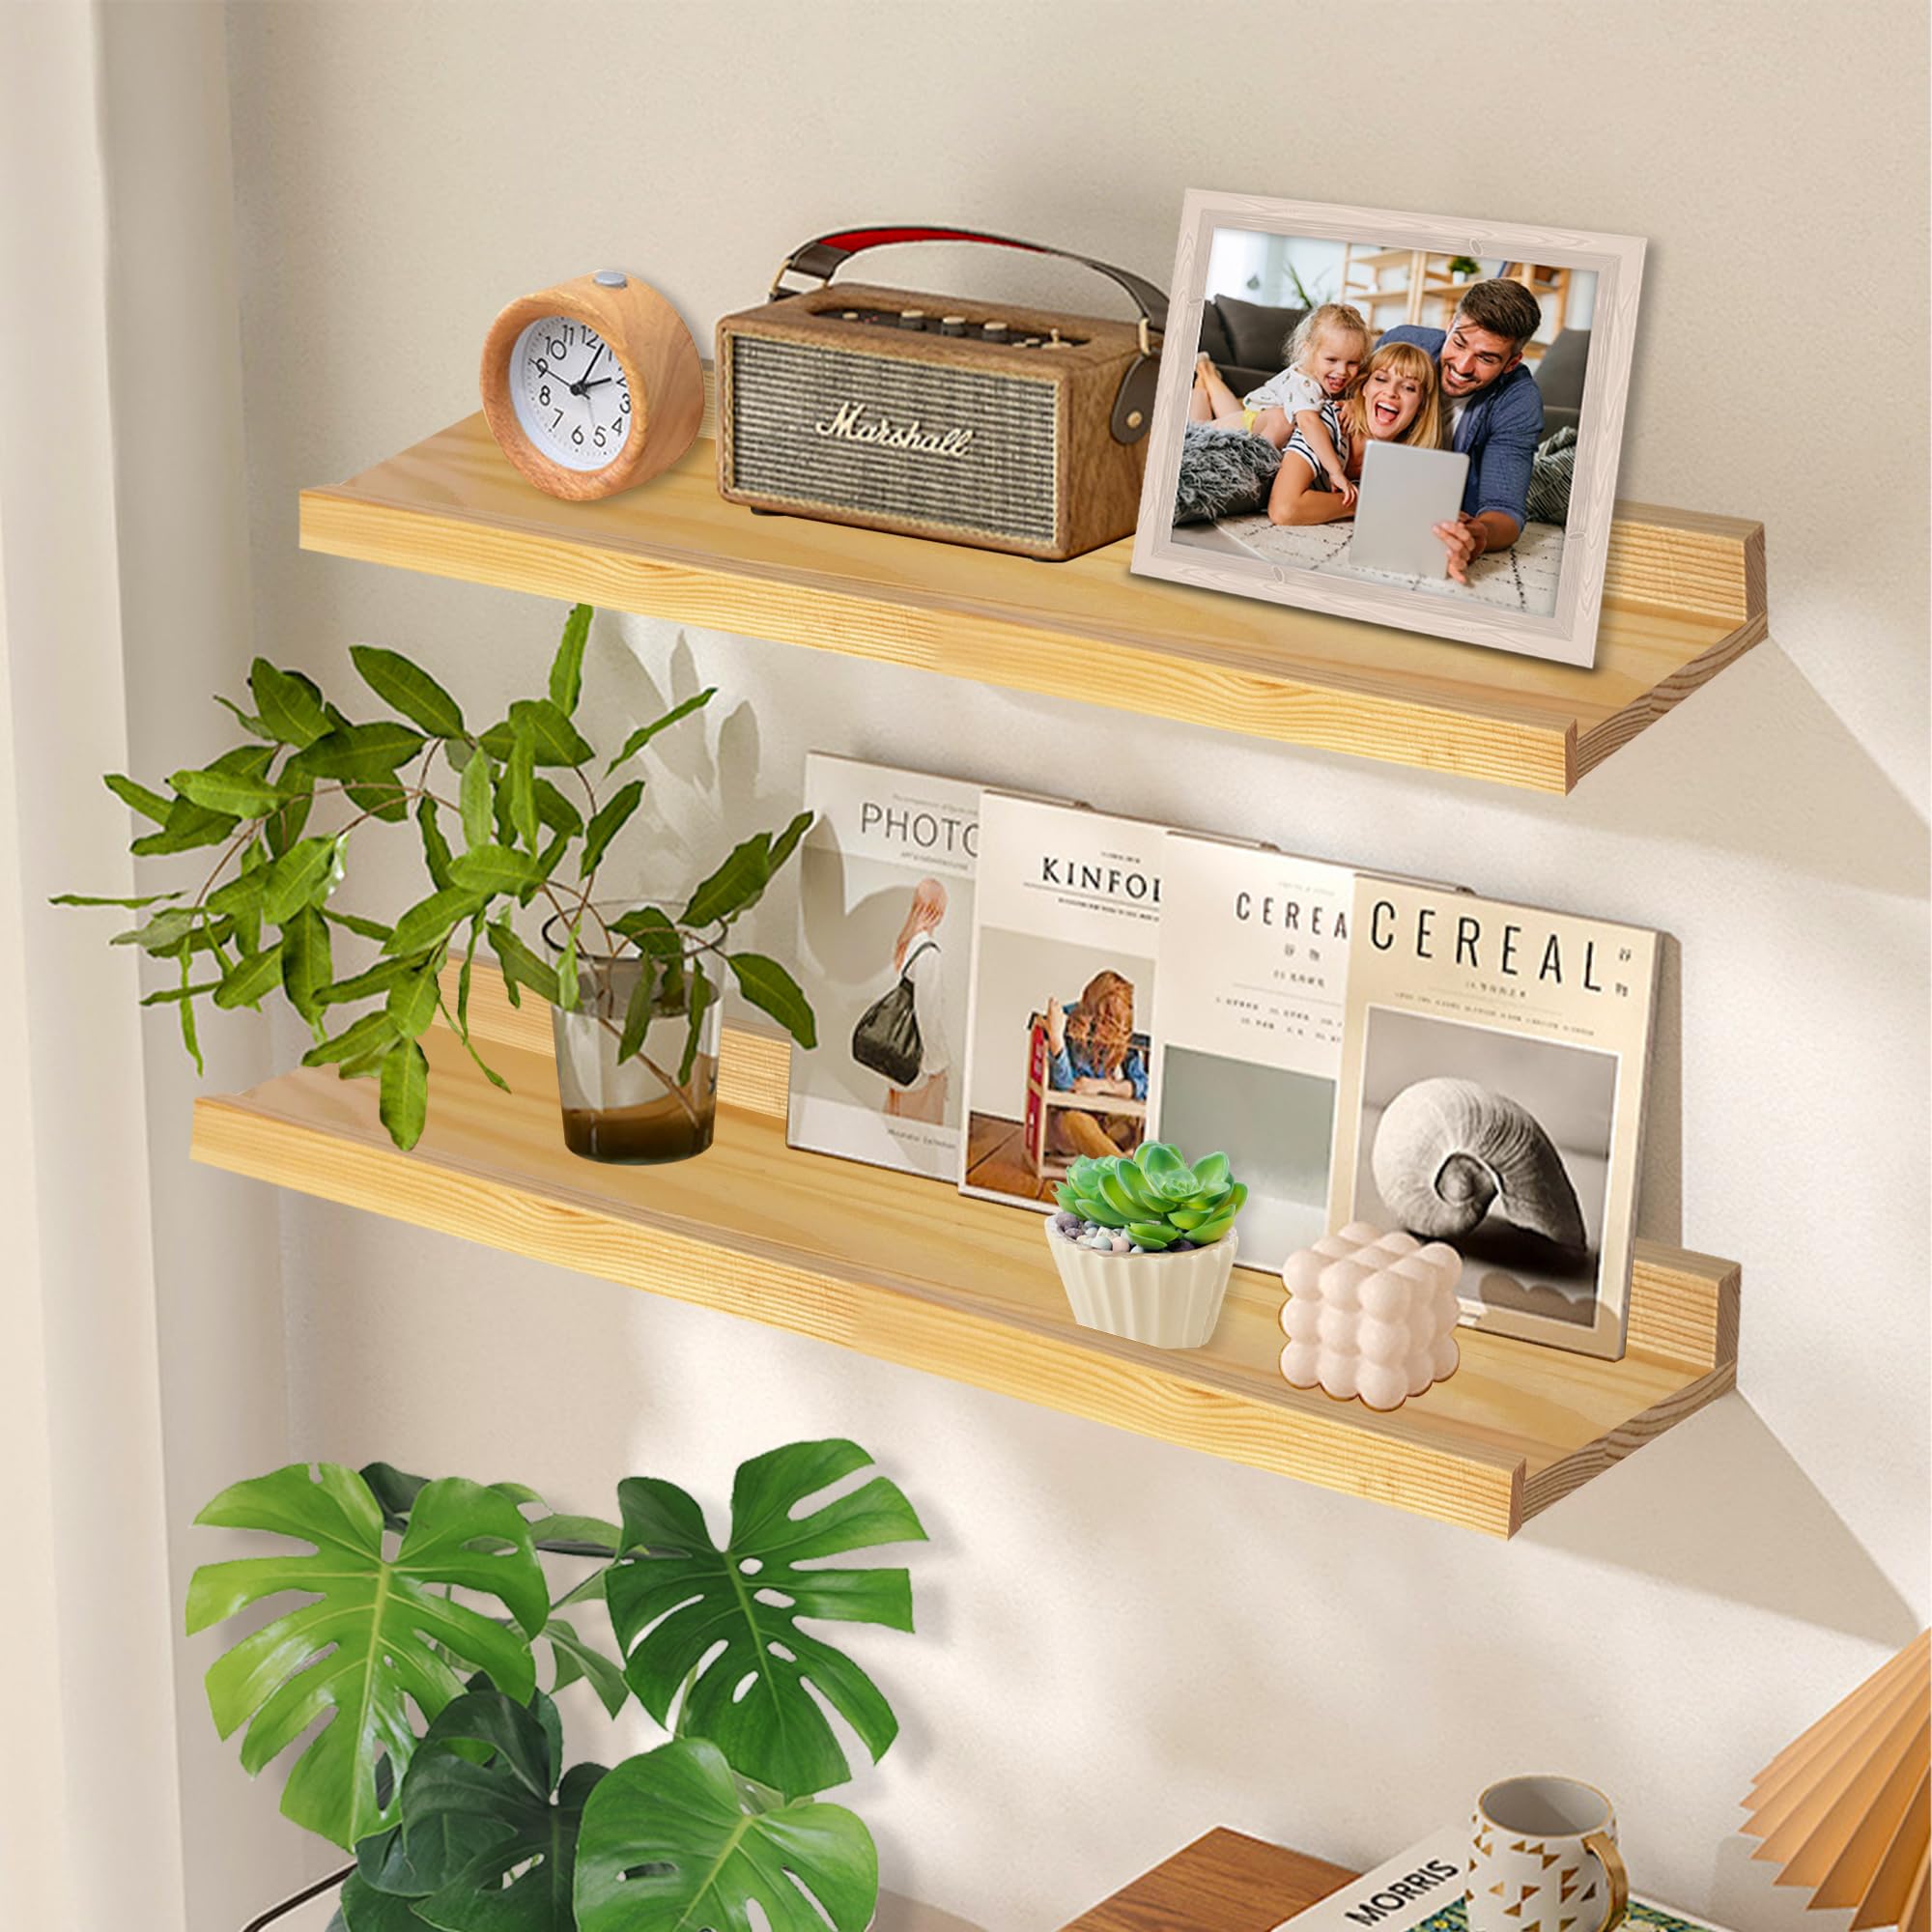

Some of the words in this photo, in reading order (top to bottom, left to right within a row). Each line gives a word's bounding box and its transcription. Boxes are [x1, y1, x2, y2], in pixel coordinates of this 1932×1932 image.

[562, 325, 574, 346] 11
[545, 336, 567, 360] 10
[536, 357, 548, 379] 9
[539, 385, 551, 407] 8
[620, 392, 631, 414] 3
[552, 408, 564, 429] 7
[611, 417, 622, 436] 4
[815, 401, 974, 457] Marshall
[572, 425, 584, 445] 6
[593, 425, 607, 447] 5
[1371, 900, 1602, 992] CEREAL
[1344, 1859, 1460, 1927] MORRIS
